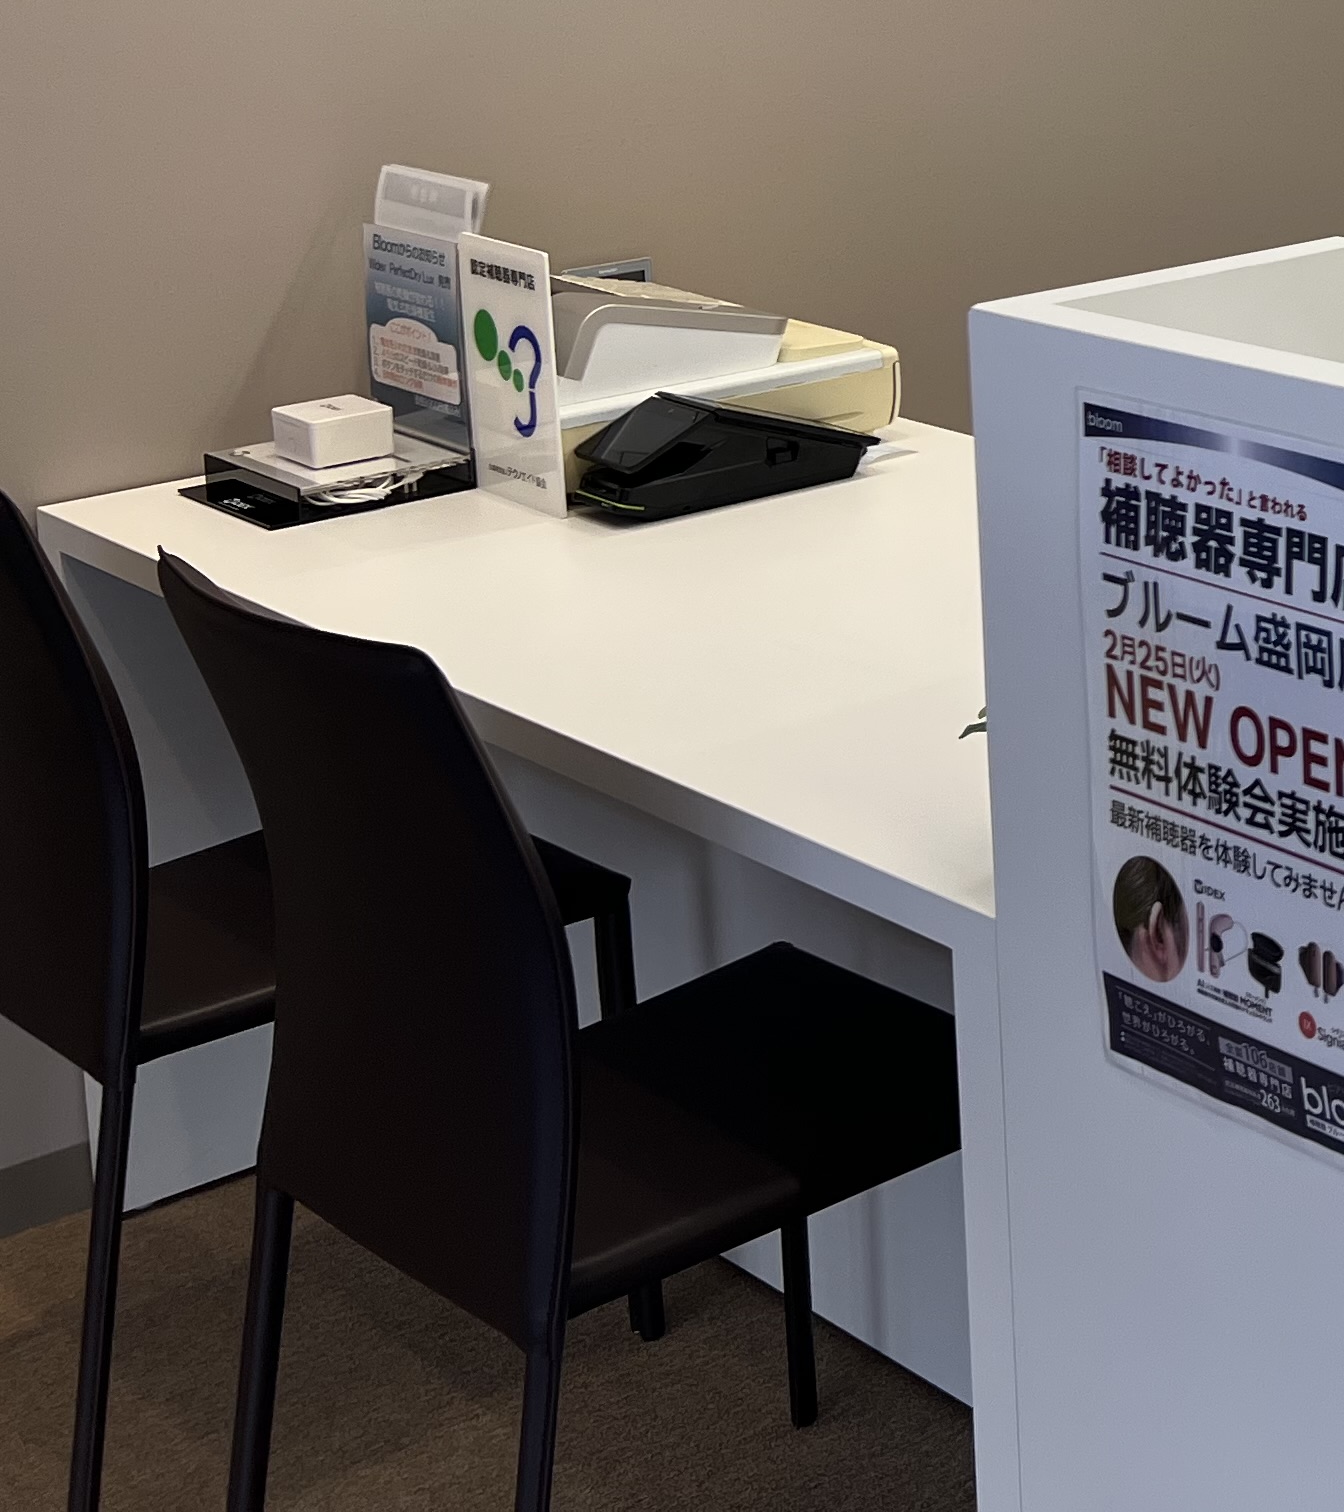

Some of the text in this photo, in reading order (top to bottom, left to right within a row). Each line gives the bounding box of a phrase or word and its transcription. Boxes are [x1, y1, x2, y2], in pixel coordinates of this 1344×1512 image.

[470, 258, 535, 291] 認定補聴器専門店
[1087, 411, 1123, 434] bloom
[1098, 446, 1308, 522] 「相談してよかった」と言われる
[1103, 628, 1222, 692] 2月25日(火)
[1105, 662, 1214, 751] NEW
[1260, 1089, 1281, 1113] 263
